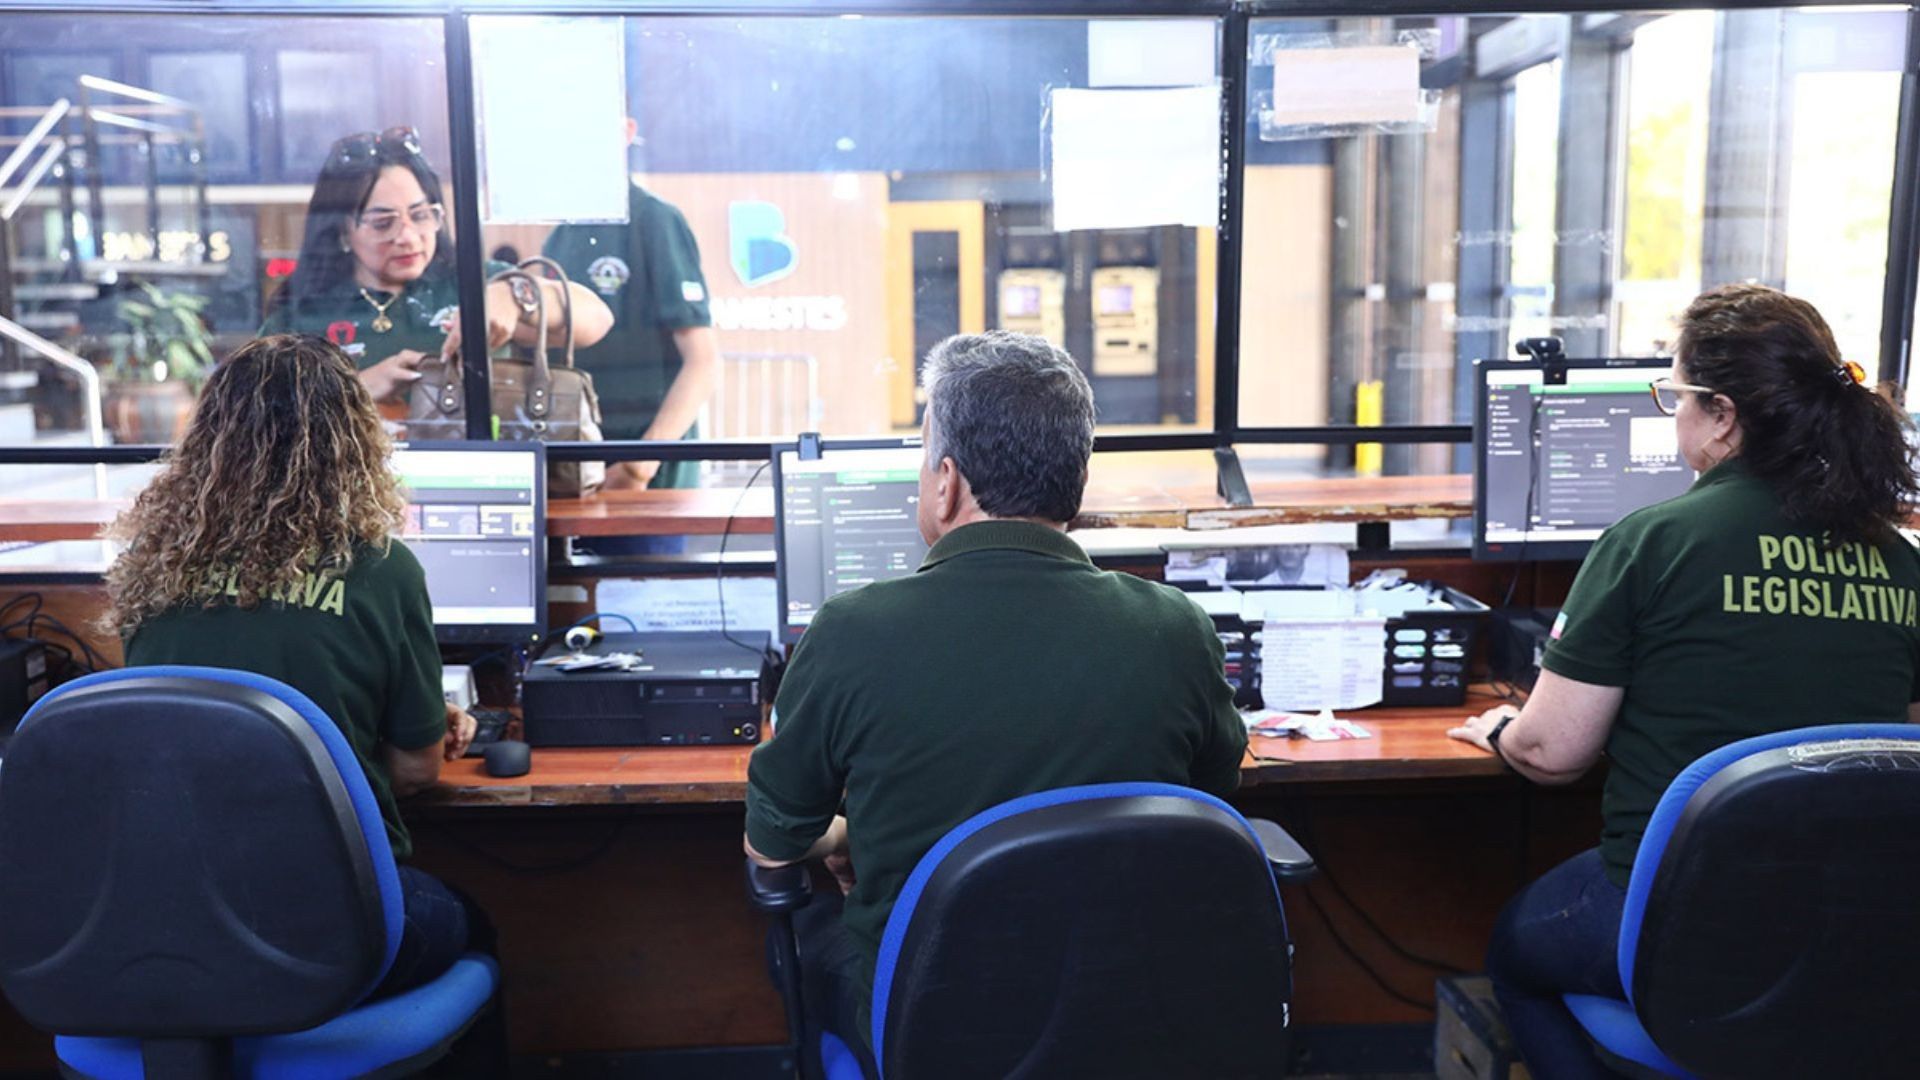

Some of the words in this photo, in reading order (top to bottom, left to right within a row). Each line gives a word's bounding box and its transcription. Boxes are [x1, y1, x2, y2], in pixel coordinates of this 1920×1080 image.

[709, 296, 848, 331] ANESTES
[1758, 530, 1890, 580] POLÍCIA
[1723, 574, 1917, 627] LEGISLATIVA
